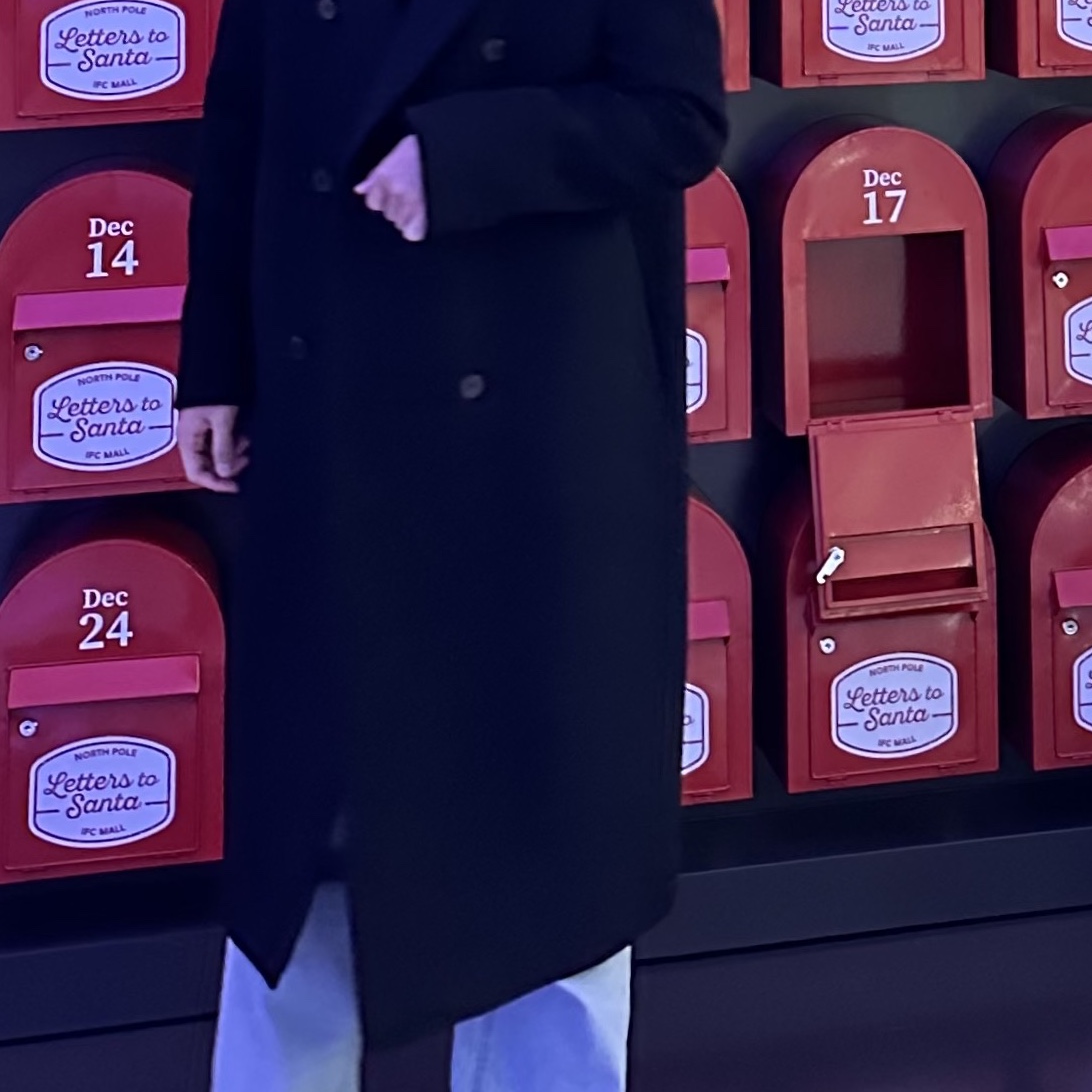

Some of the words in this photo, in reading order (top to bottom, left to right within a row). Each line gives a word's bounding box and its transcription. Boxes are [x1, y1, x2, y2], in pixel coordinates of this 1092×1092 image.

[85, 6, 119, 17] NORTH
[122, 5, 147, 15] POLE
[854, 14, 916, 35] Santa
[55, 27, 144, 53] Letters
[148, 28, 169, 43] to
[883, 43, 904, 51] MALL
[78, 48, 152, 71] Santa
[111, 79, 137, 87] MALL
[863, 170, 901, 187] Dec
[863, 189, 906, 224] 17
[89, 218, 133, 237] Dec
[86, 240, 139, 277] 14
[78, 374, 113, 385] NORTH
[115, 374, 140, 382] POLE
[47, 396, 137, 422] Letters
[141, 397, 161, 411] to
[70, 418, 145, 442] Santa
[104, 448, 130, 458] MALL
[83, 589, 128, 609] Dec
[79, 611, 133, 650] 24
[869, 664, 899, 677] NORTH
[902, 664, 924, 672] POLE
[844, 687, 920, 712] Letters
[926, 685, 944, 700] to
[864, 707, 929, 731] Santa
[894, 735, 917, 747] MALL
[74, 749, 109, 762] NORTH
[113, 749, 137, 757] POLE
[43, 772, 133, 799] Letters
[138, 772, 159, 787] to
[66, 793, 142, 819] Santa
[99, 824, 126, 835] MALL
